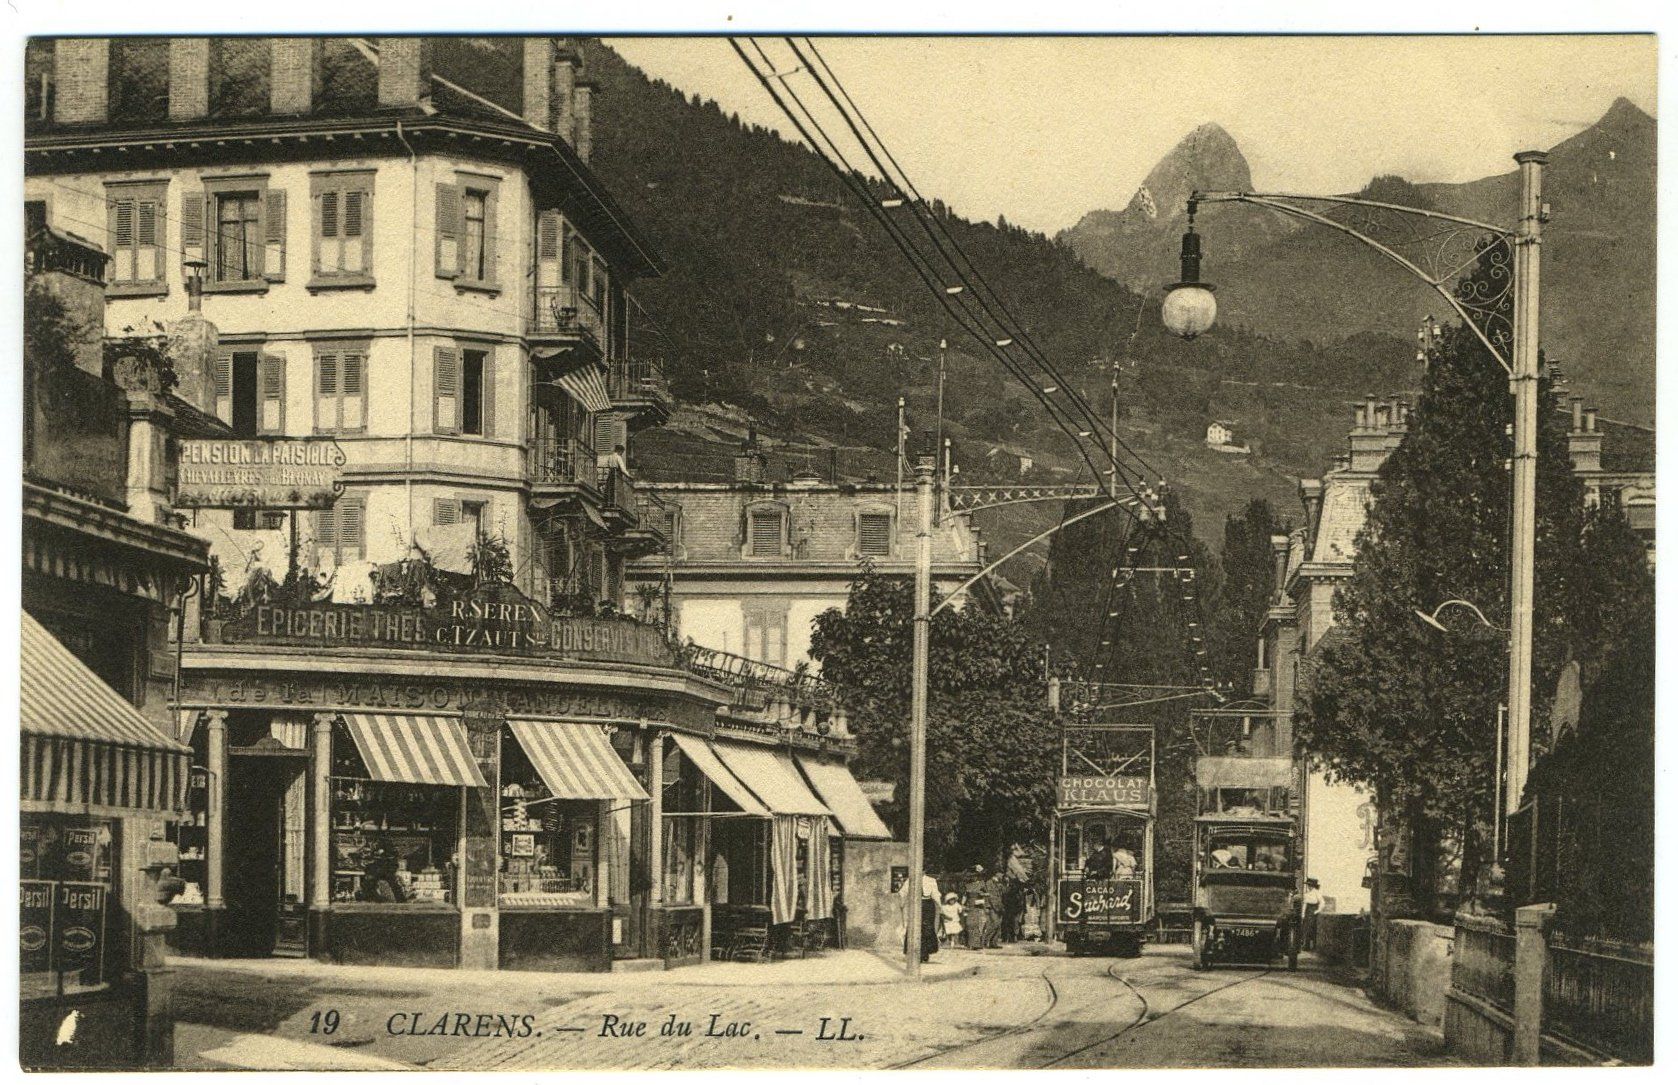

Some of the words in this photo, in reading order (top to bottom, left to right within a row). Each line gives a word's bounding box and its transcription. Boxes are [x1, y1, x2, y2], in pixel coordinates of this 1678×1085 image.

[181, 443, 251, 465] PENSION
[272, 443, 334, 466] PAISIBLE
[257, 605, 362, 639] EPICERIE
[336, 683, 473, 711] MAISON
[1062, 778, 1143, 788] CHOCOLAT
[1064, 789, 1141, 801] KLAUS
[68, 831, 95, 846] Persil
[1085, 886, 1115, 894] CACAO
[1065, 888, 1133, 918] Suchard
